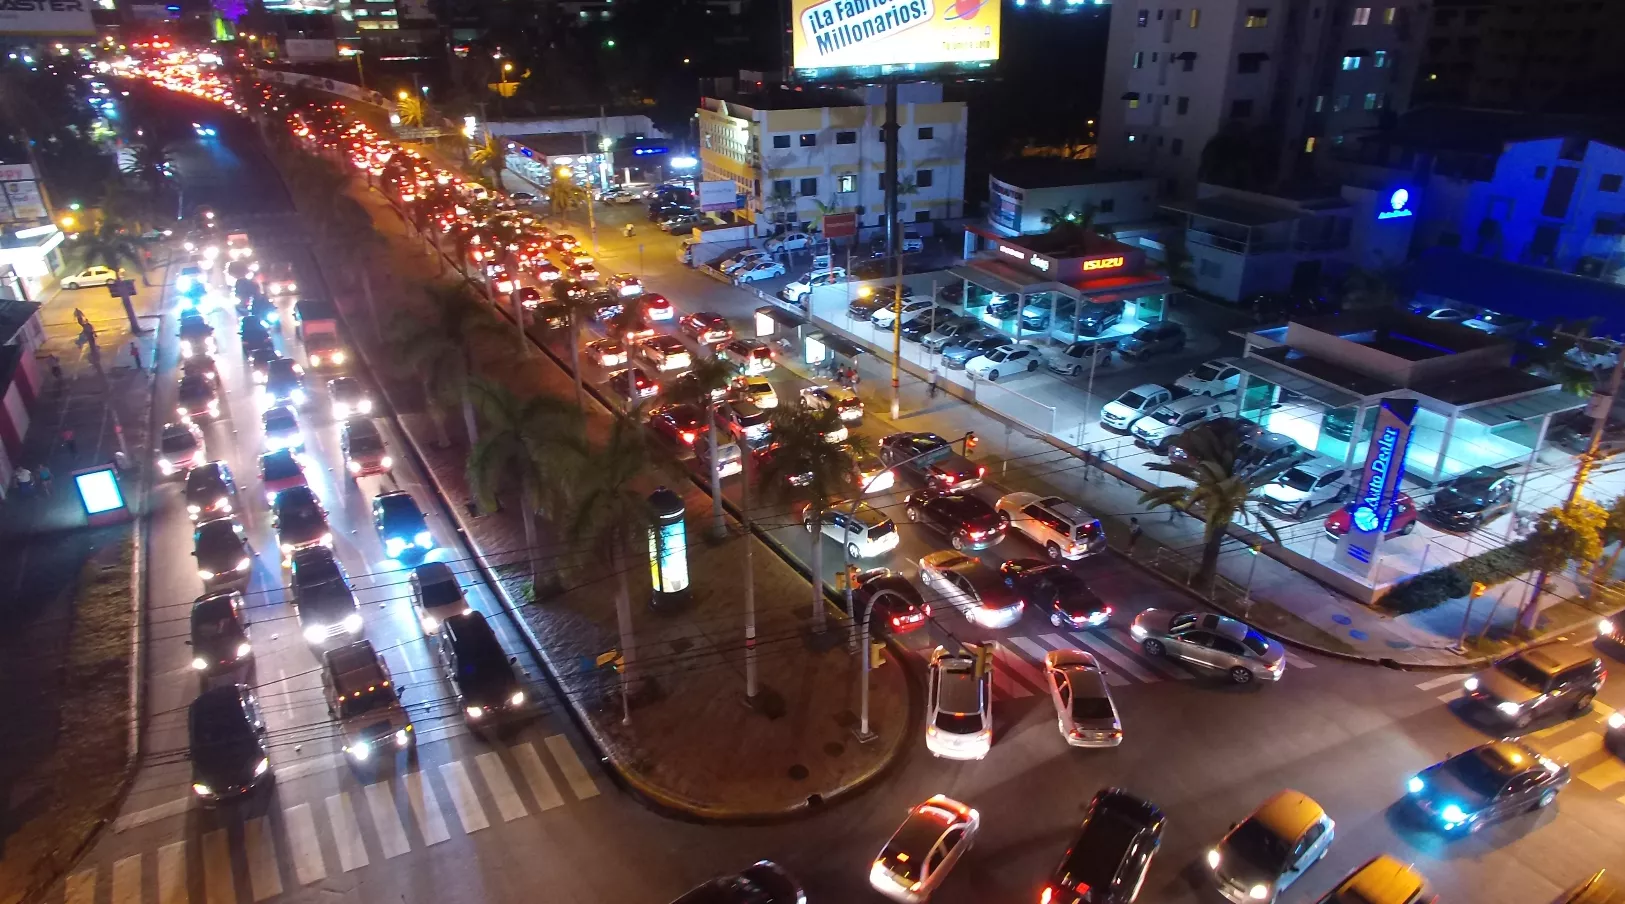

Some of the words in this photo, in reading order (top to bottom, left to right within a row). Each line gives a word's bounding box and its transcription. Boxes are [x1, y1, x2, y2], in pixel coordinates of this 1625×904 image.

[0, 0, 84, 12] ASTER
[816, 0, 928, 57] Millonarios!
[1083, 257, 1123, 270] ISUZU
